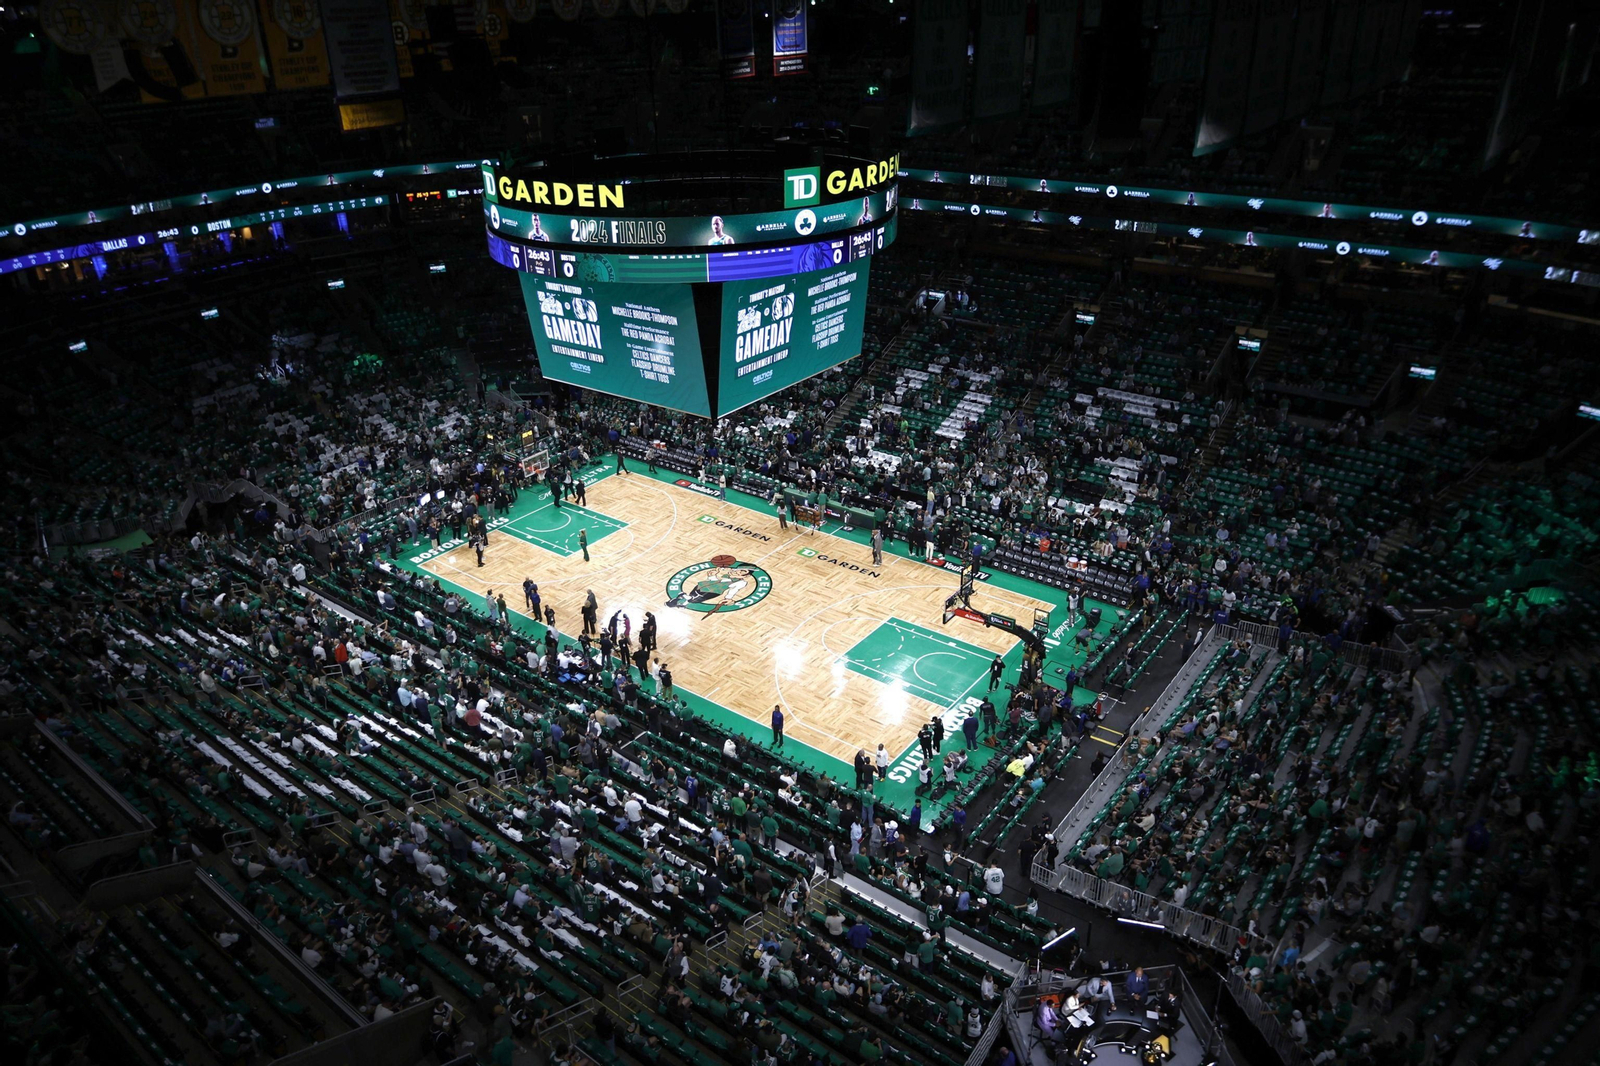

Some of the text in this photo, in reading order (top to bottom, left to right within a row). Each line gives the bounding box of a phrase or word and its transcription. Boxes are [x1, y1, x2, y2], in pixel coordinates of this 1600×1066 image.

[787, 152, 900, 200] TD GARDEN
[482, 170, 624, 208] TD GARDEN
[102, 220, 232, 252] DALLAS 0 26:43 0 BOSTON
[570, 219, 666, 244] 2024 FINALS
[853, 231, 872, 247] 26:43
[512, 254, 520, 268] 0
[528, 249, 550, 262] 26:43
[833, 248, 843, 264] 0
[564, 262, 574, 278] 0
[542, 314, 602, 350] GAMEDAY
[735, 316, 793, 362] GAMEDAY
[552, 344, 588, 360] ENTERTAINMENT
[738, 355, 773, 377] ENTERTAINMENT
[714, 520, 772, 542] GARDEN
[409, 538, 464, 564] BOSTON
[801, 549, 881, 578] TD GARDEN
[670, 562, 770, 608] BOSTON CELTICS
[975, 572, 990, 580] TV
